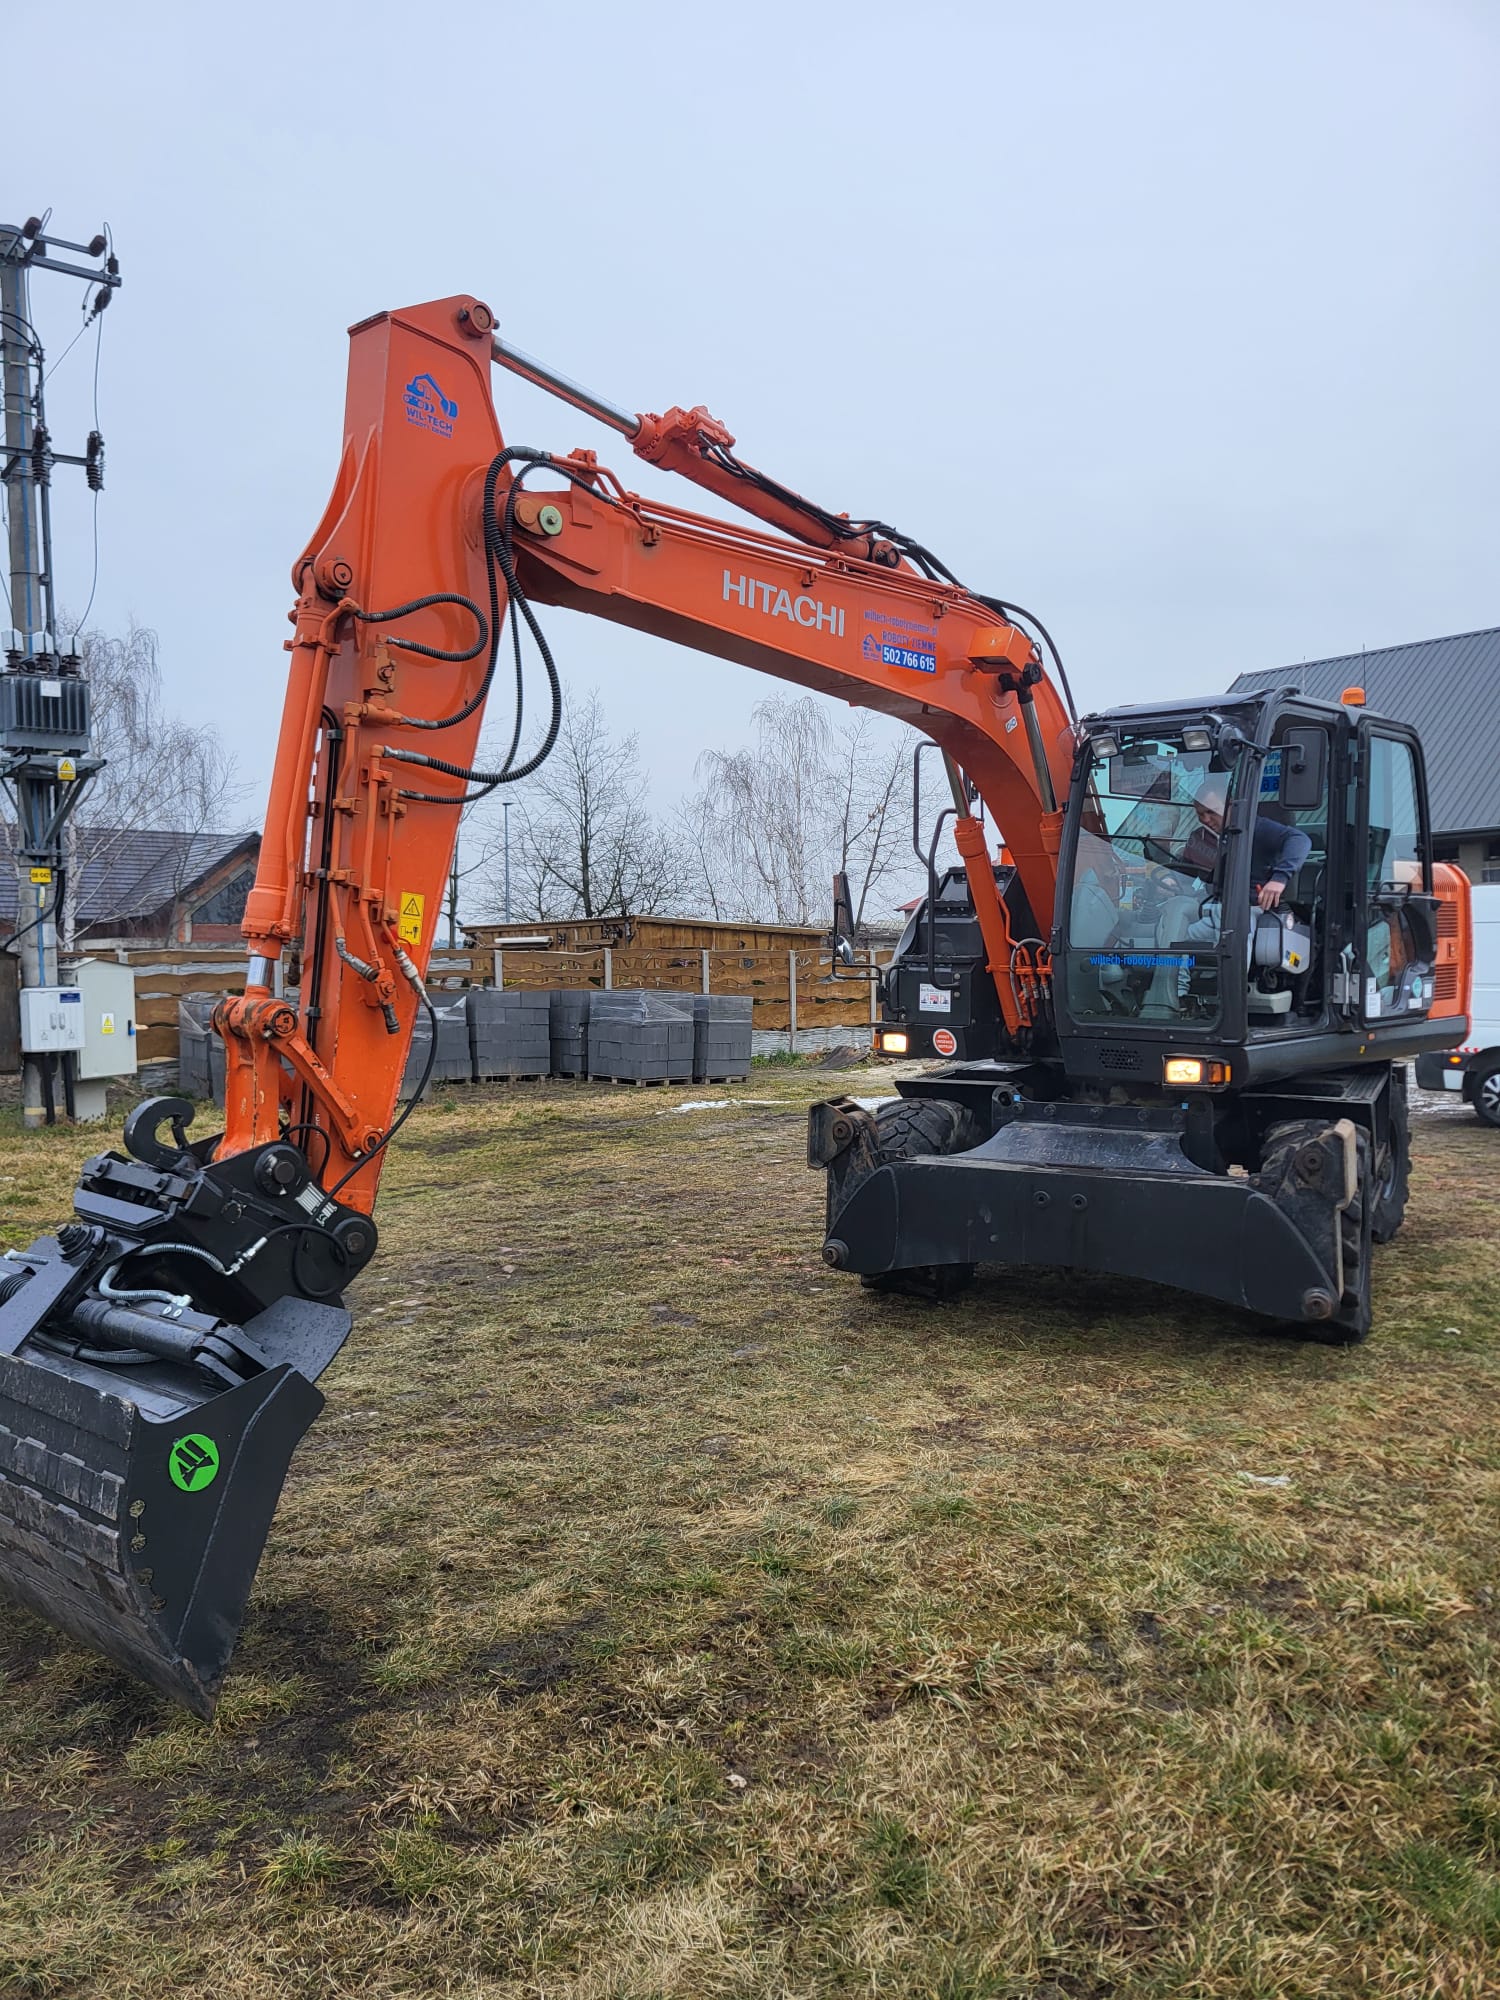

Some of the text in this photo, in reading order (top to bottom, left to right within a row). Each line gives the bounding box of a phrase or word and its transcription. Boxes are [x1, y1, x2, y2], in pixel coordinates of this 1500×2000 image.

[406, 406, 453, 433] WIL-TECH
[722, 569, 845, 638] HITACHI
[882, 630, 937, 653] ROBOTY ZIEMNE
[883, 646, 901, 665] 502
[902, 650, 918, 668] 766
[919, 655, 935, 672] 615
